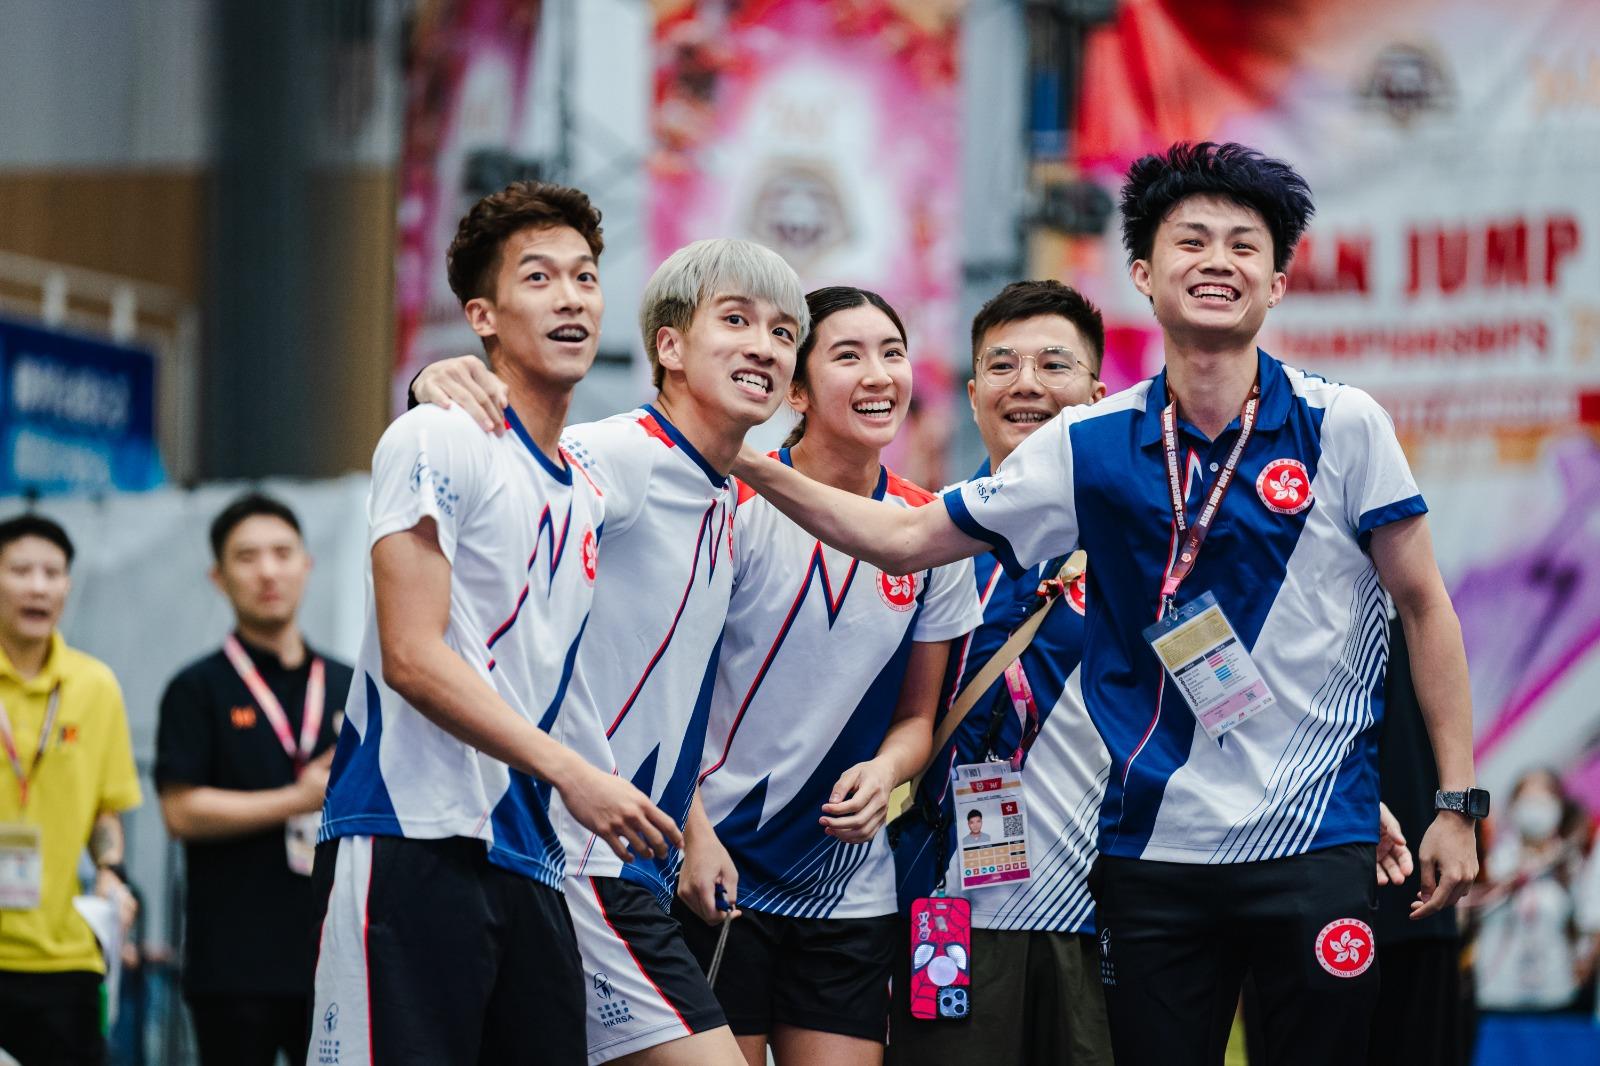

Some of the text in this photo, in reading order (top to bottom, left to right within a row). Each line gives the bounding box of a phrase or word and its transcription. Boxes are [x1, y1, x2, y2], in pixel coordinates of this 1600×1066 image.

[1404, 215, 1580, 297] JUMP
[1165, 432, 1176, 451] ROPE
[1209, 486, 1223, 507] JUMP
[1217, 468, 1232, 489] ROPE
[1225, 414, 1254, 469] CHAMPIONSHIPS
[1167, 451, 1183, 511] CHAMPIONSHIPS
[603, 1014, 634, 1028] HKRSA
